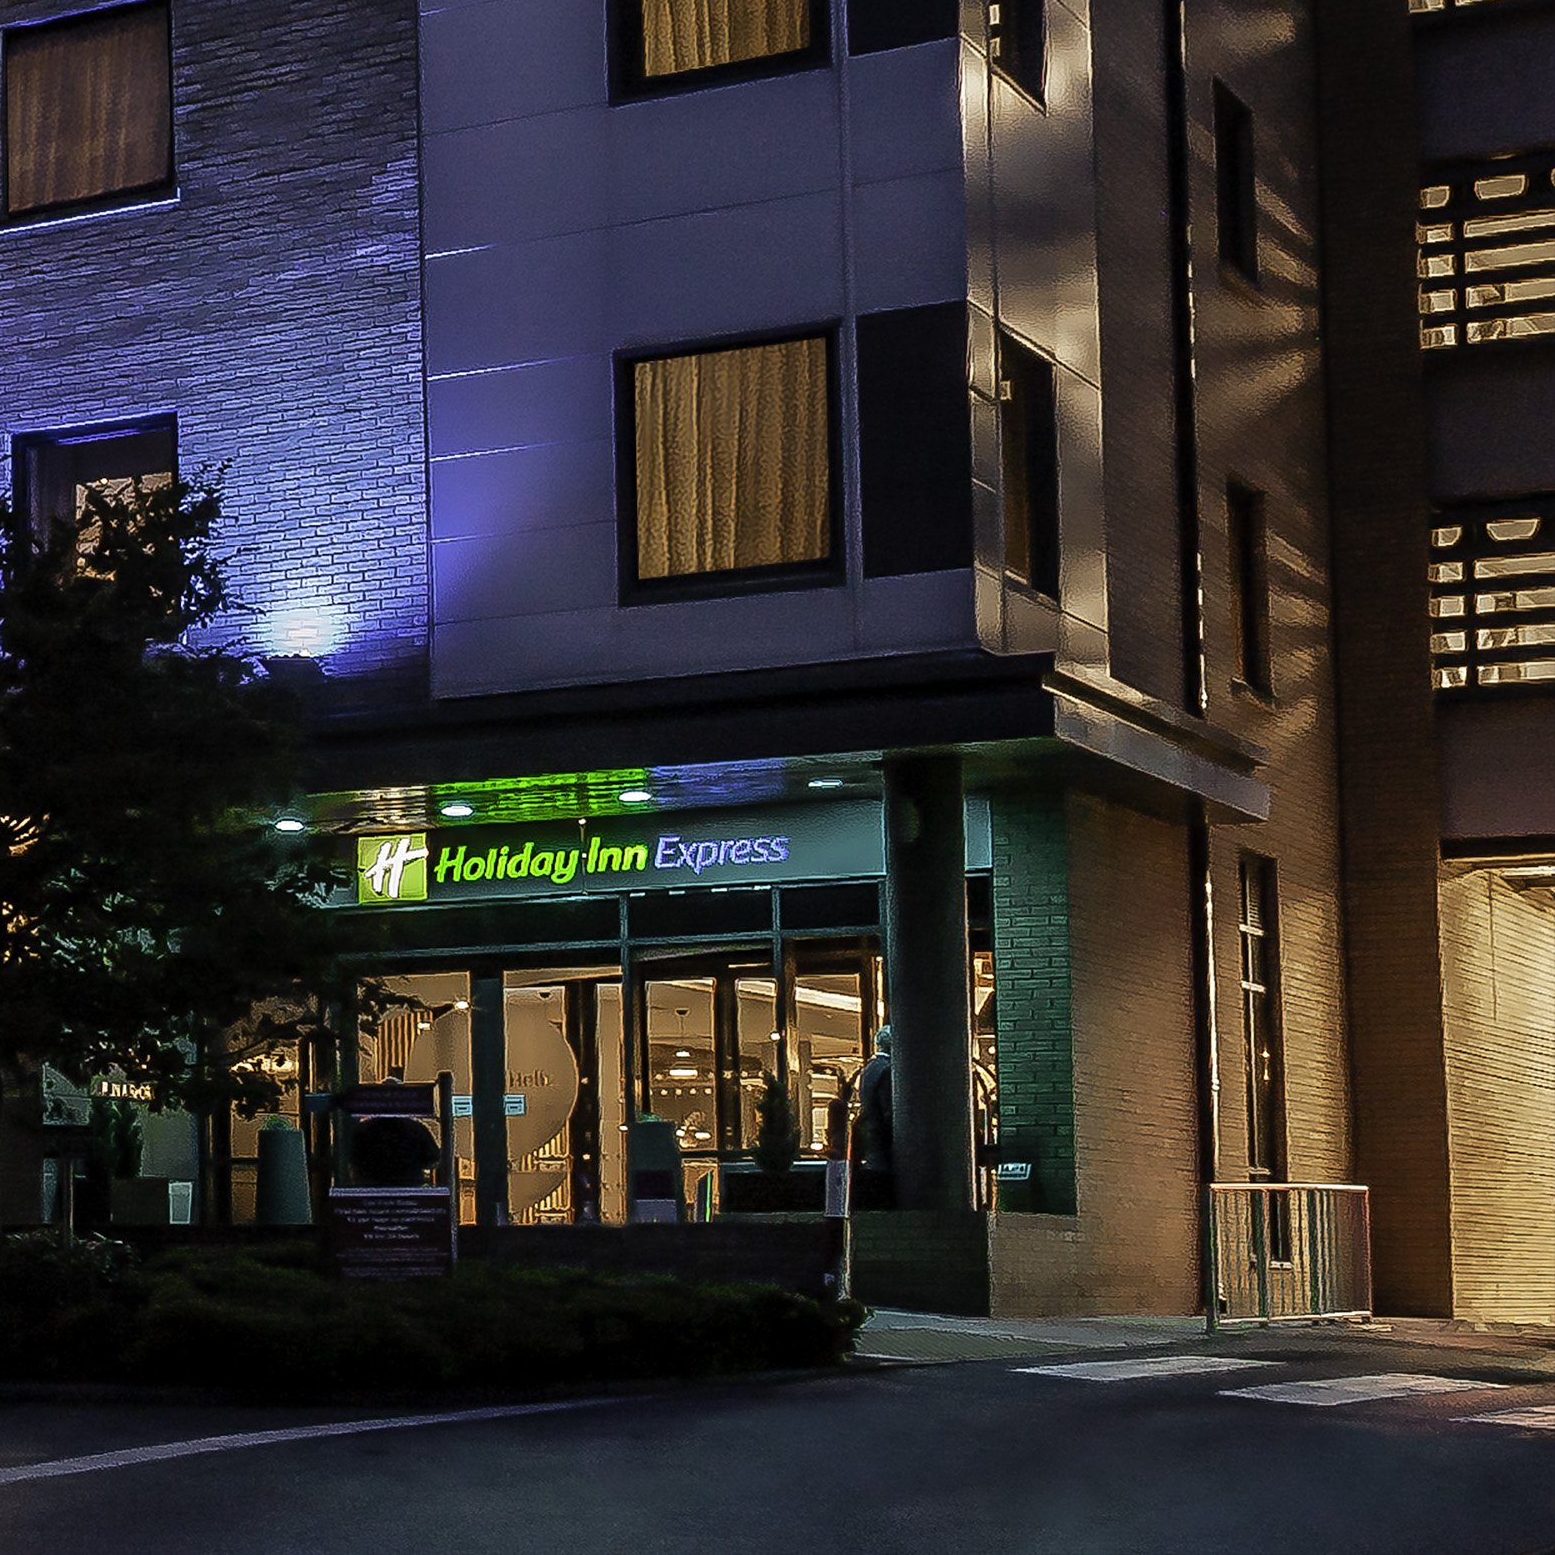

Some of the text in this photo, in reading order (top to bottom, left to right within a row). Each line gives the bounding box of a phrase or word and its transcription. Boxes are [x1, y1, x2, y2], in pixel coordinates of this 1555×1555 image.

[434, 834, 790, 885] Holiday Inn Express
